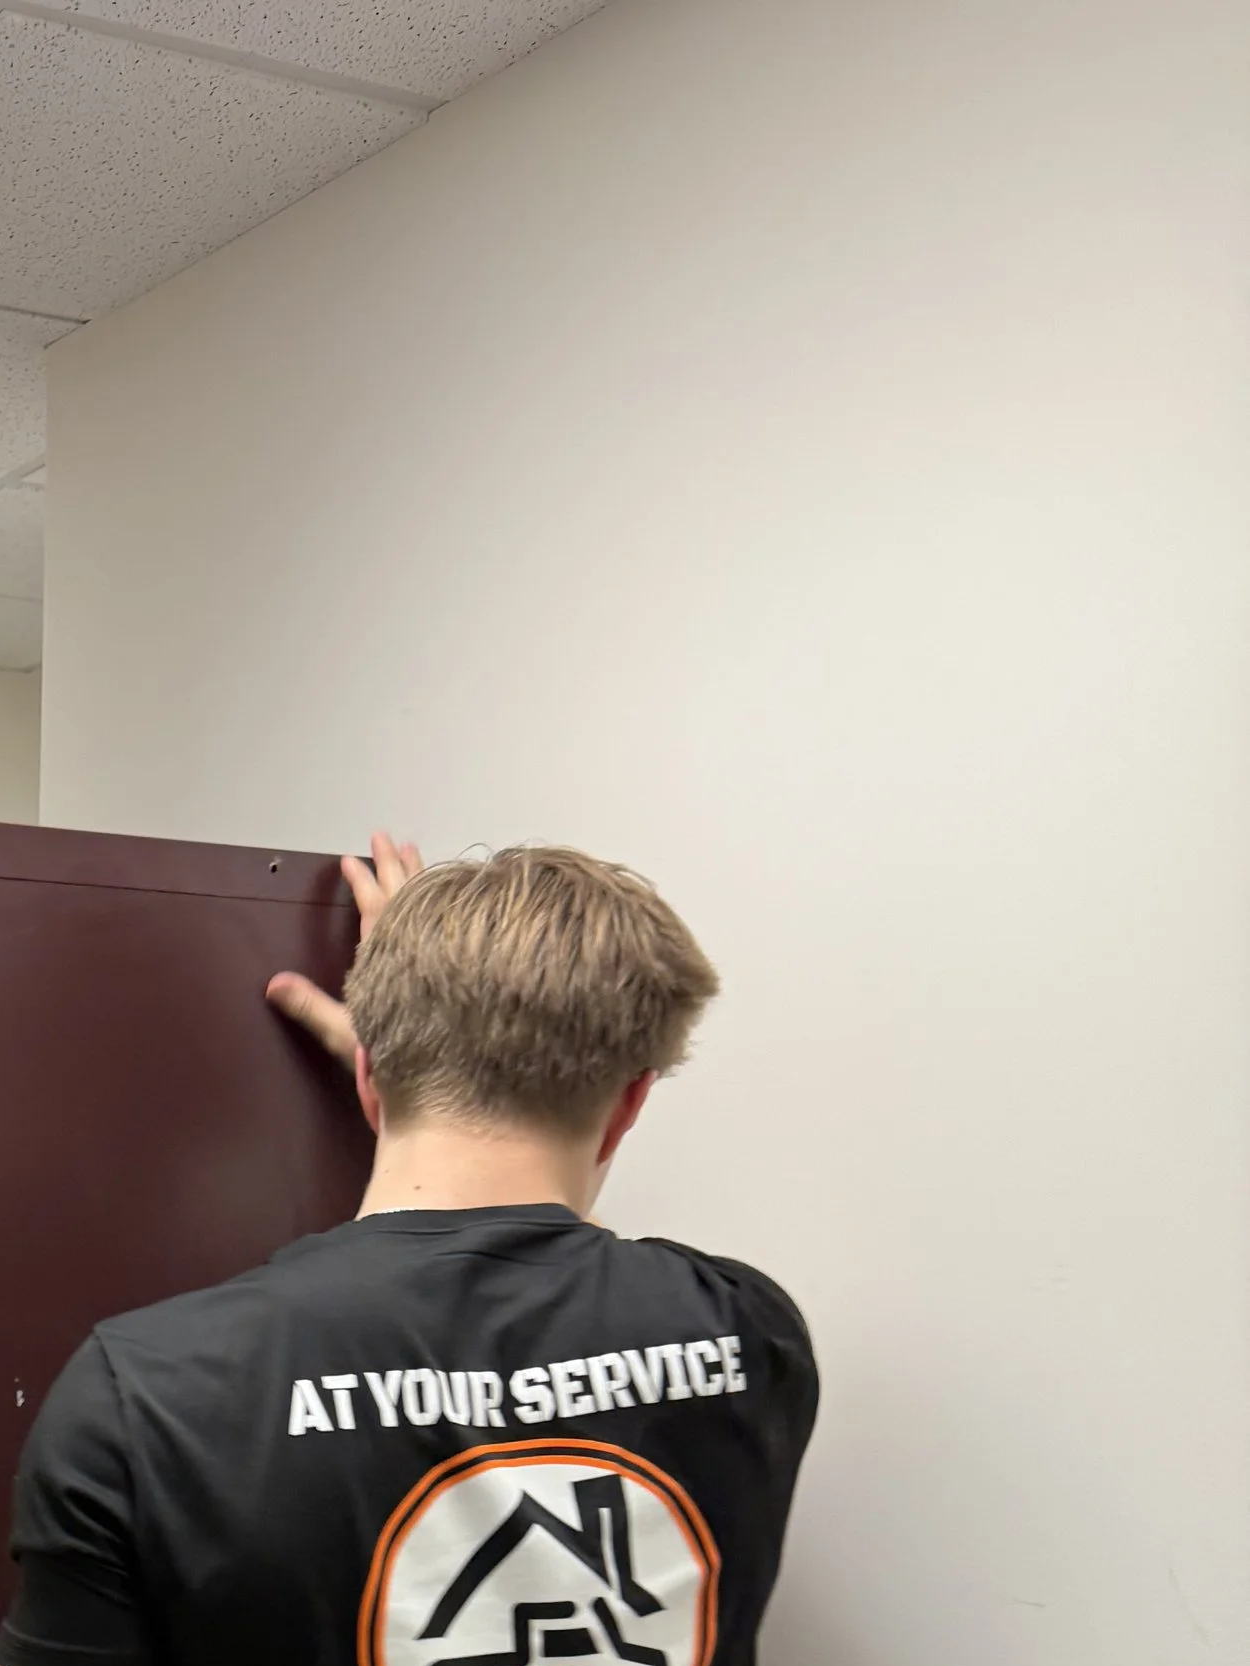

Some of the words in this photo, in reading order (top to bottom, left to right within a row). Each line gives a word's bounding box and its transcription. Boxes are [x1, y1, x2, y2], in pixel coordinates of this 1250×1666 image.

[288, 1373, 359, 1436] AT
[363, 1367, 508, 1428] YOUR
[508, 1335, 747, 1425] SERVICE
